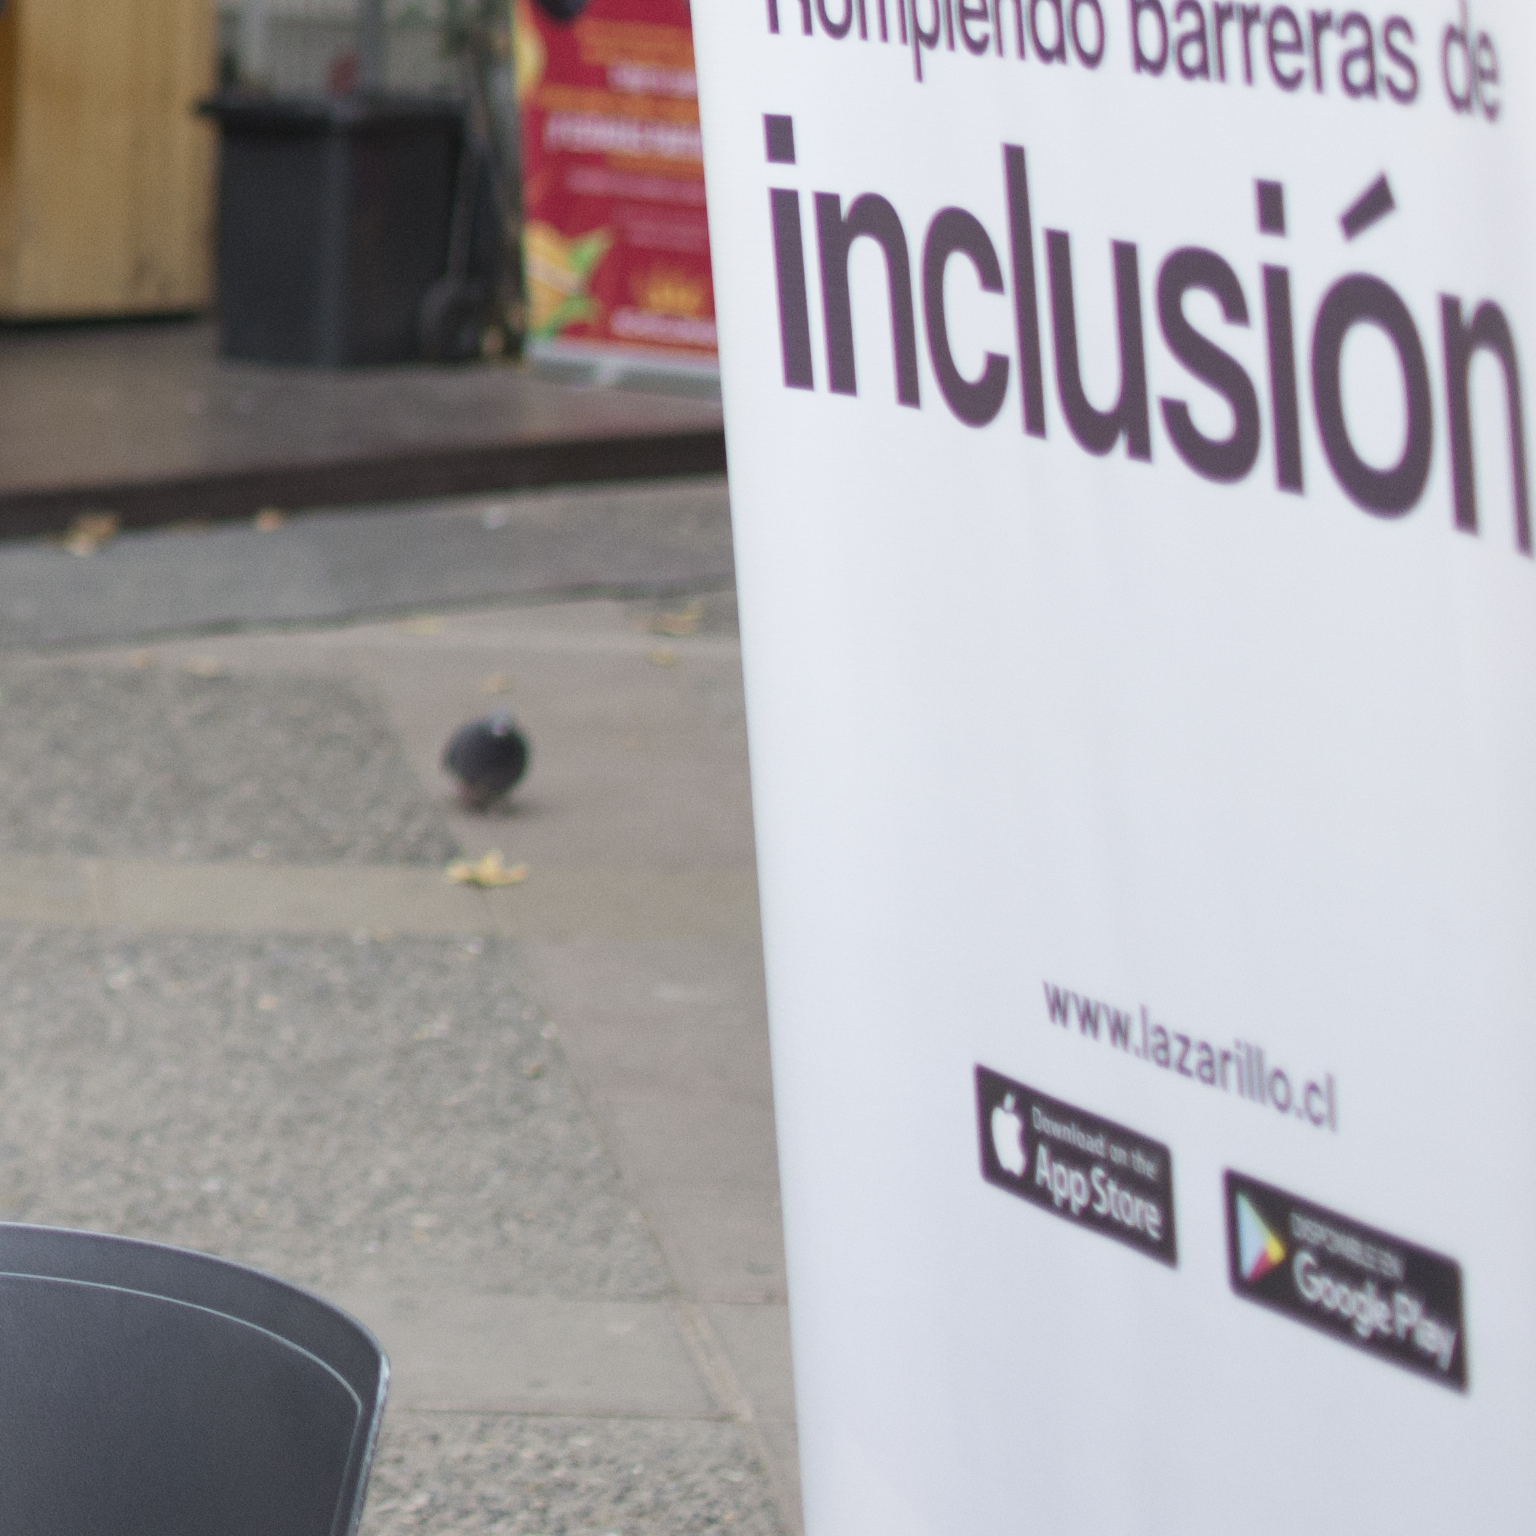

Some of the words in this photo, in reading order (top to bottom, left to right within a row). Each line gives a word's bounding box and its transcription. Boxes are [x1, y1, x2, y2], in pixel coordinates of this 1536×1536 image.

[762, 112, 1534, 560] inclusión
[1042, 979, 1338, 1134] www.lazarillo.cl
[1031, 1105, 1106, 1158] Download
[1034, 1142, 1090, 1214] App
[1090, 1165, 1163, 1241] Store
[1292, 1249, 1393, 1339] Google
[1393, 1290, 1459, 1372] Play
